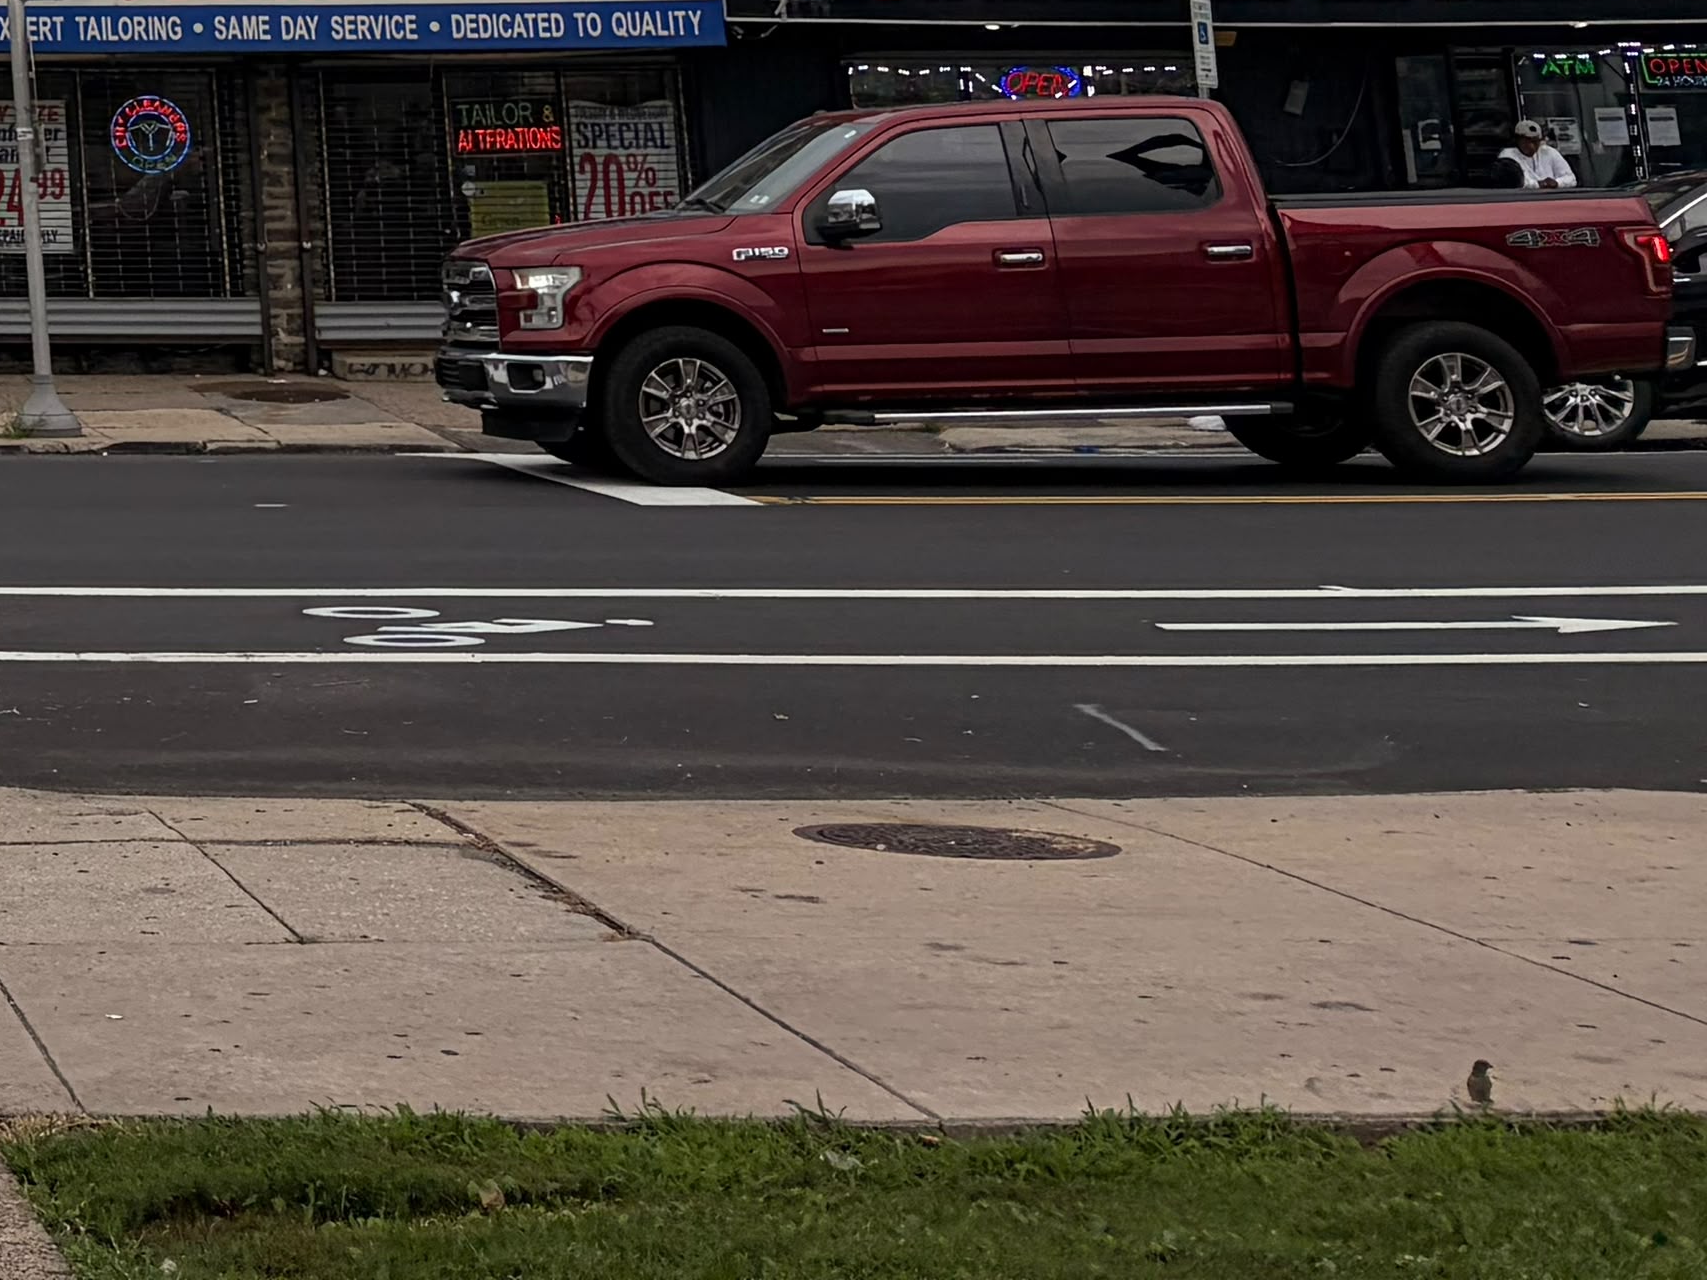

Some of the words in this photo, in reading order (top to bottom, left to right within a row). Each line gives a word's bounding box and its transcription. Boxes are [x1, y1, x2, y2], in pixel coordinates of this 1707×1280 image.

[75, 16, 183, 42] TAILORING
[213, 15, 272, 41] SAME
[280, 15, 320, 41] DAY
[330, 14, 419, 41] SERVICE
[450, 13, 566, 40] DEDICATED
[573, 12, 603, 38] TO
[611, 10, 703, 39] QUALITY
[1540, 57, 1596, 76] ATM
[456, 102, 534, 127] TAILOR
[542, 104, 555, 123] &
[576, 122, 671, 150] SPECIAL
